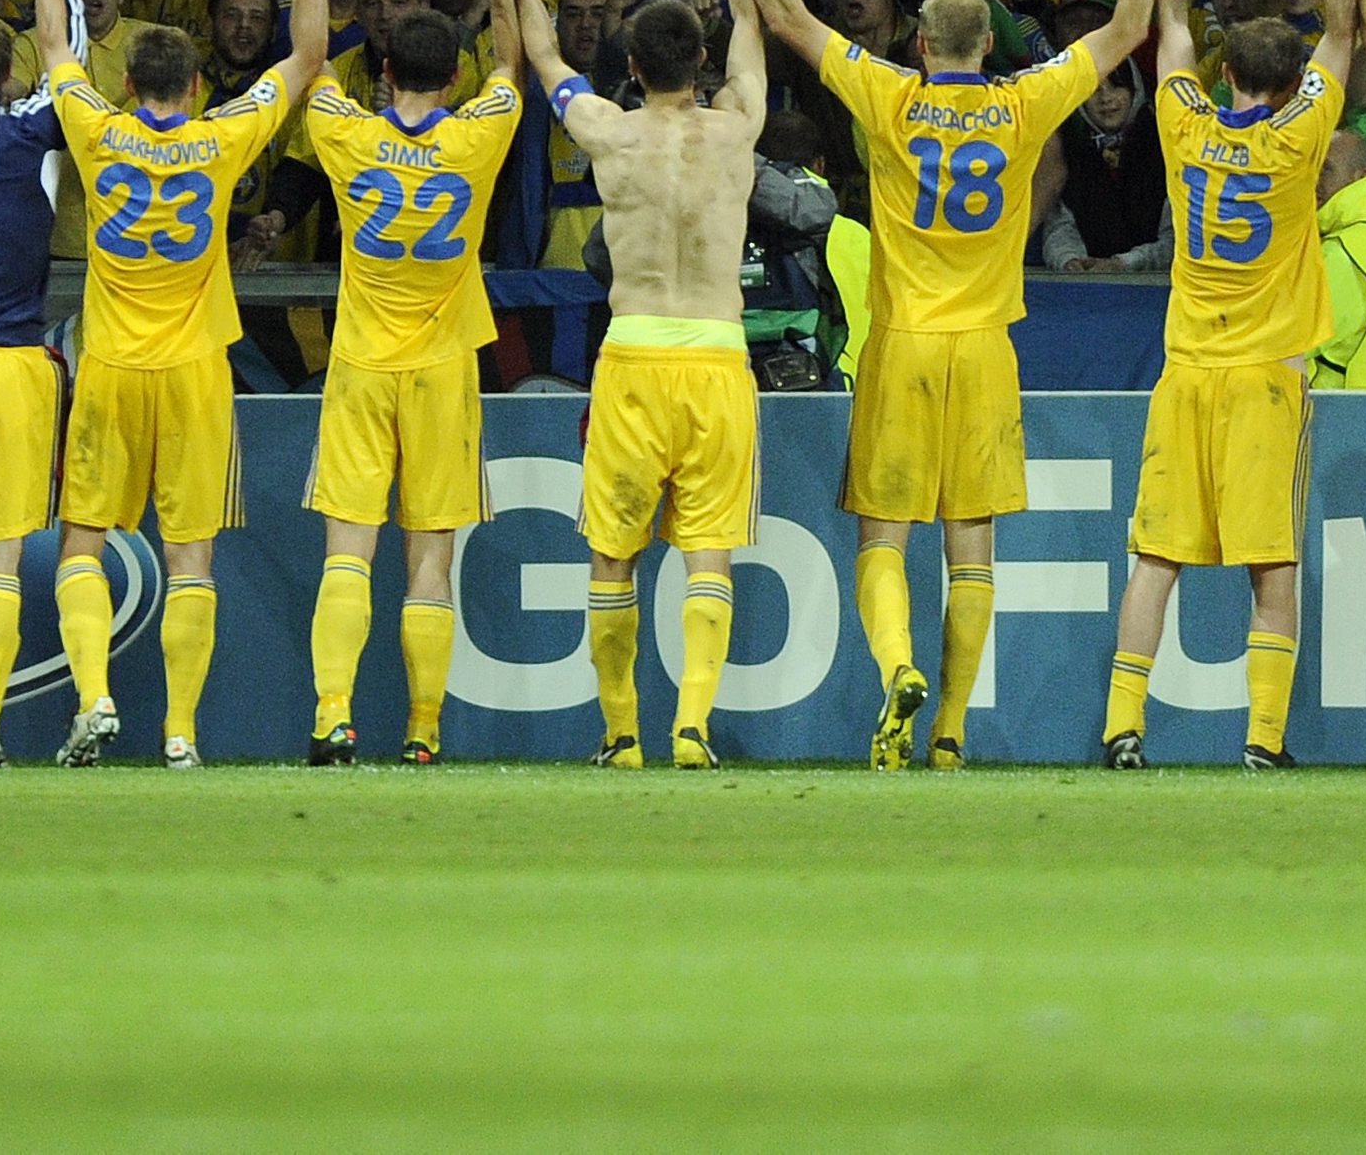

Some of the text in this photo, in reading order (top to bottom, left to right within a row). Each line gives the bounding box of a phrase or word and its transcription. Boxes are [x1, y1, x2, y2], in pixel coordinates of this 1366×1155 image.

[100, 126, 221, 165] ALIAKHNOVICH
[907, 100, 1013, 132] BARDACHOU
[1200, 141, 1251, 168] HLEB
[95, 161, 215, 263] 23
[347, 166, 473, 261] 22
[907, 135, 1008, 233] 18
[1181, 164, 1273, 263] 15
[441, 457, 841, 712] Go
